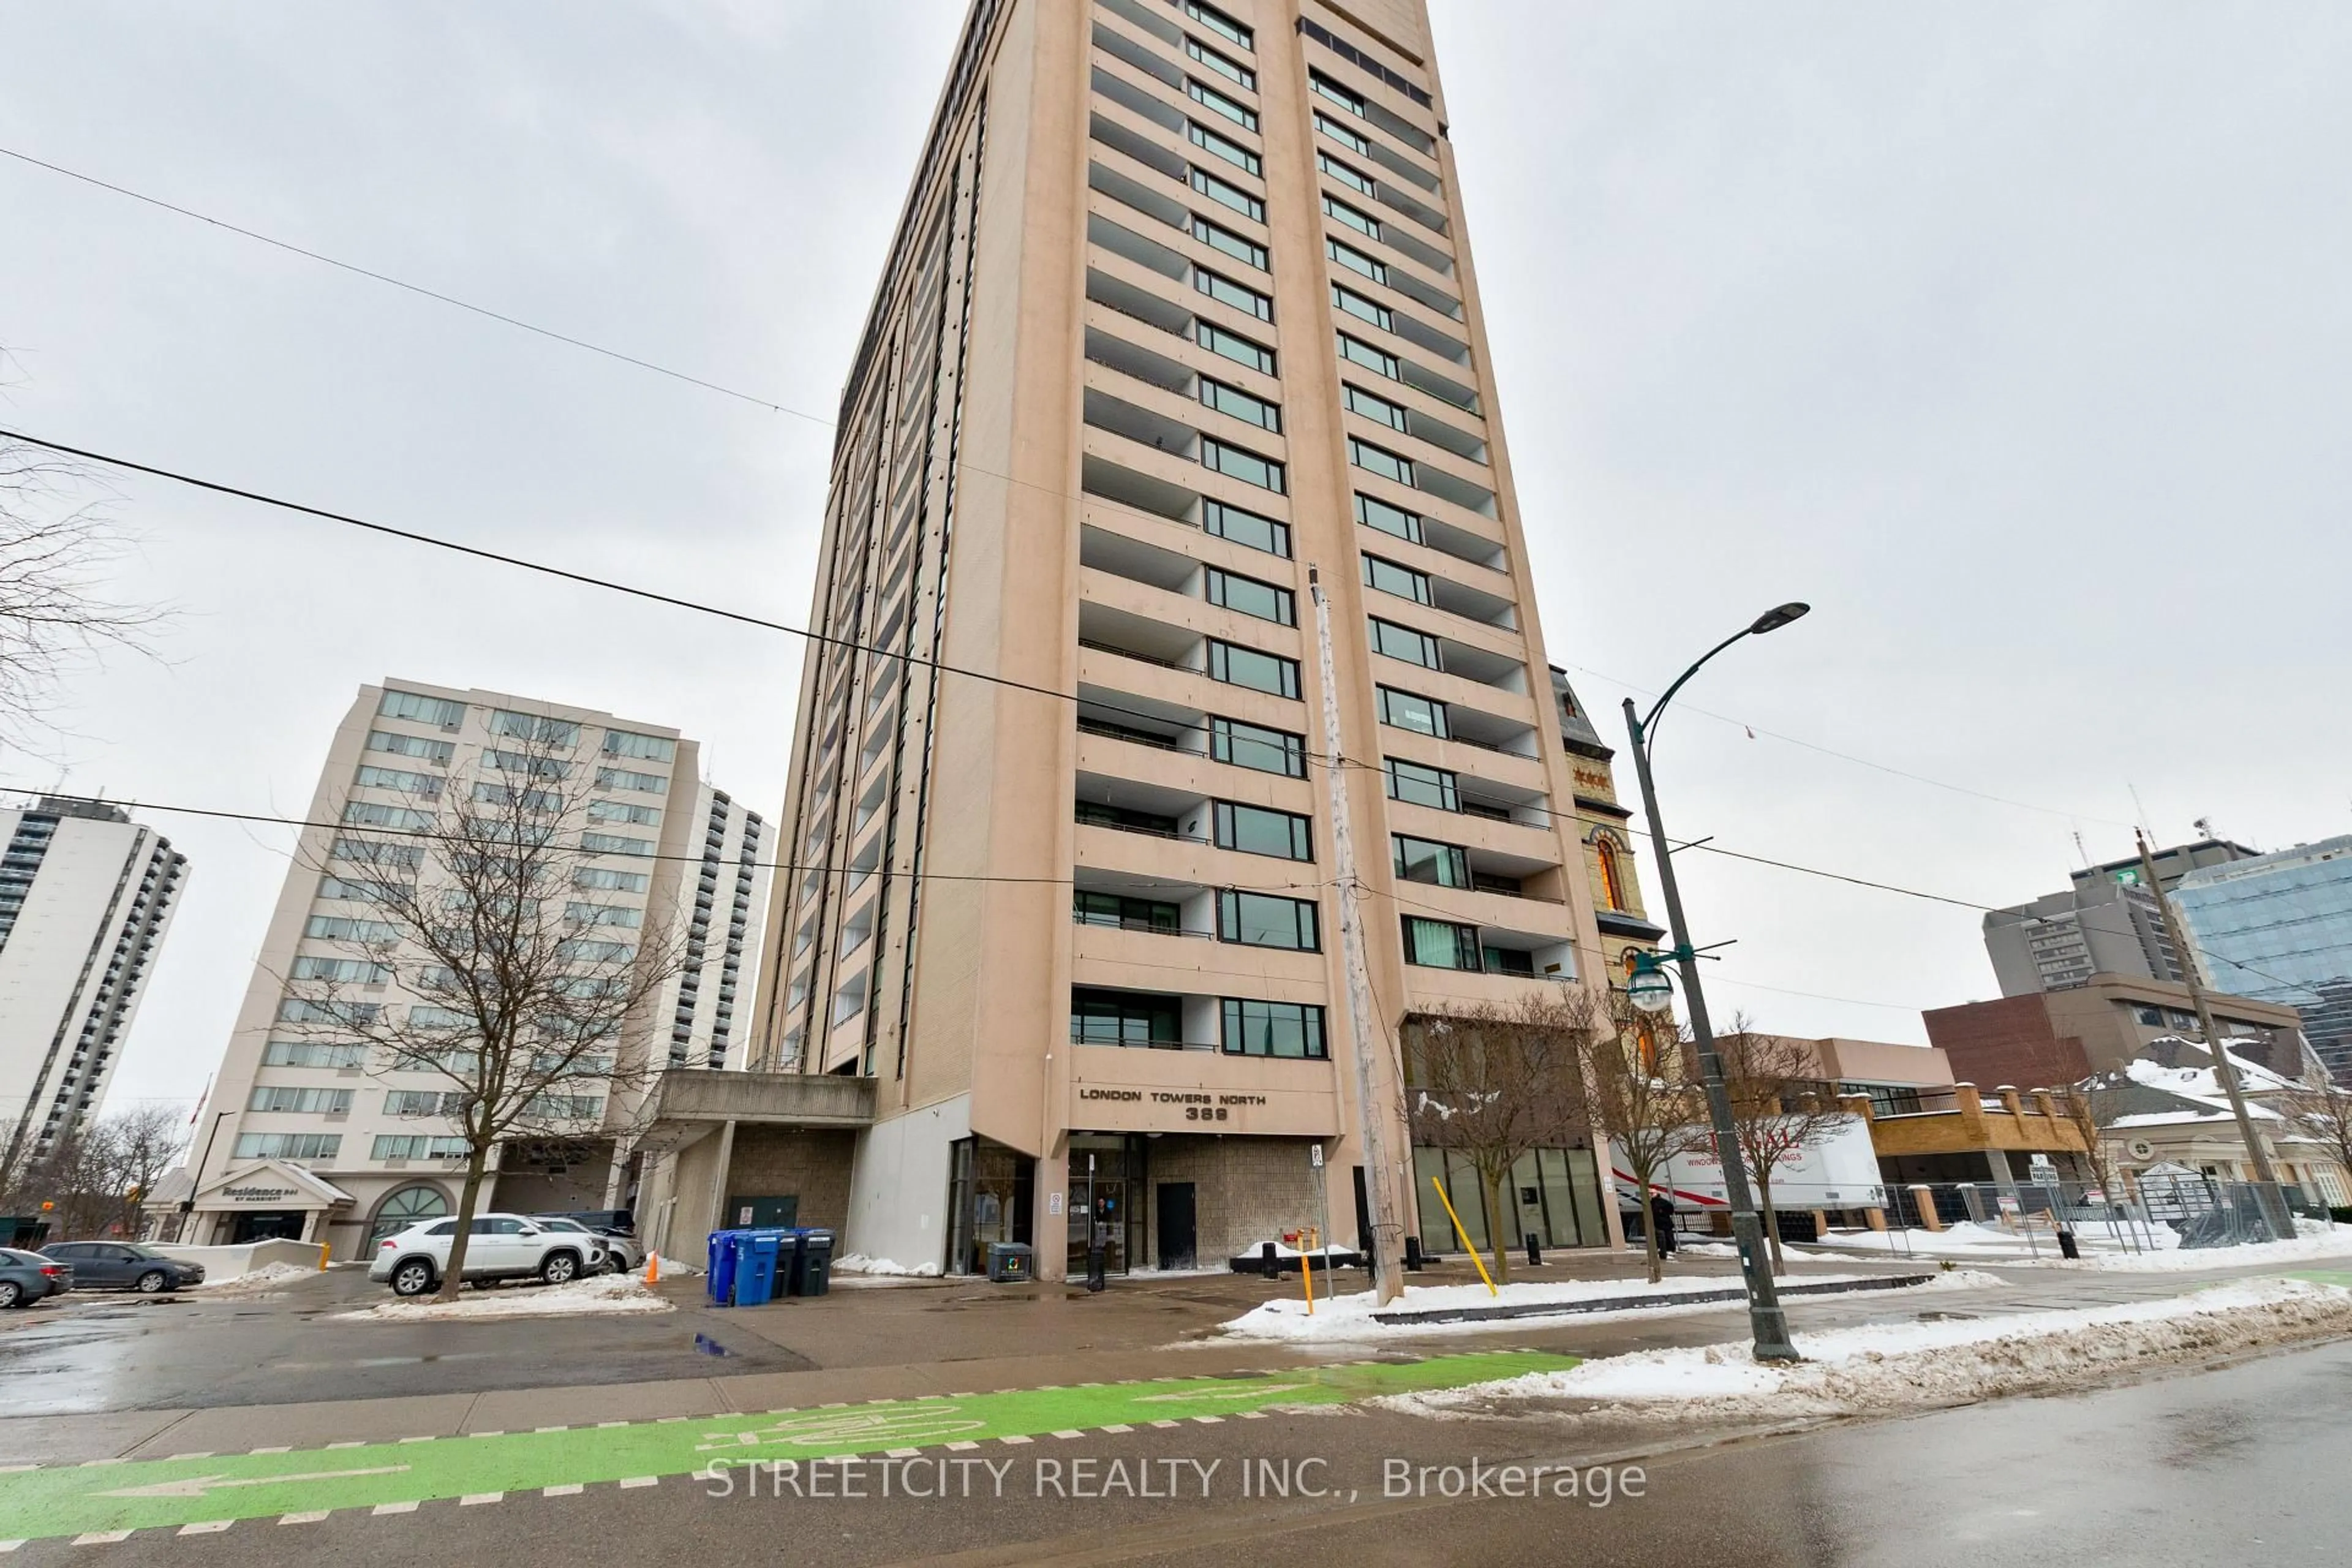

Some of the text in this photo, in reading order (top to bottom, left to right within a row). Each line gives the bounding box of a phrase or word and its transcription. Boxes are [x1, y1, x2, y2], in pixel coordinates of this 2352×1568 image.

[1080, 1089, 1266, 1105] LONDON TOWERS NORTH
[222, 1187, 282, 1196] Residence
